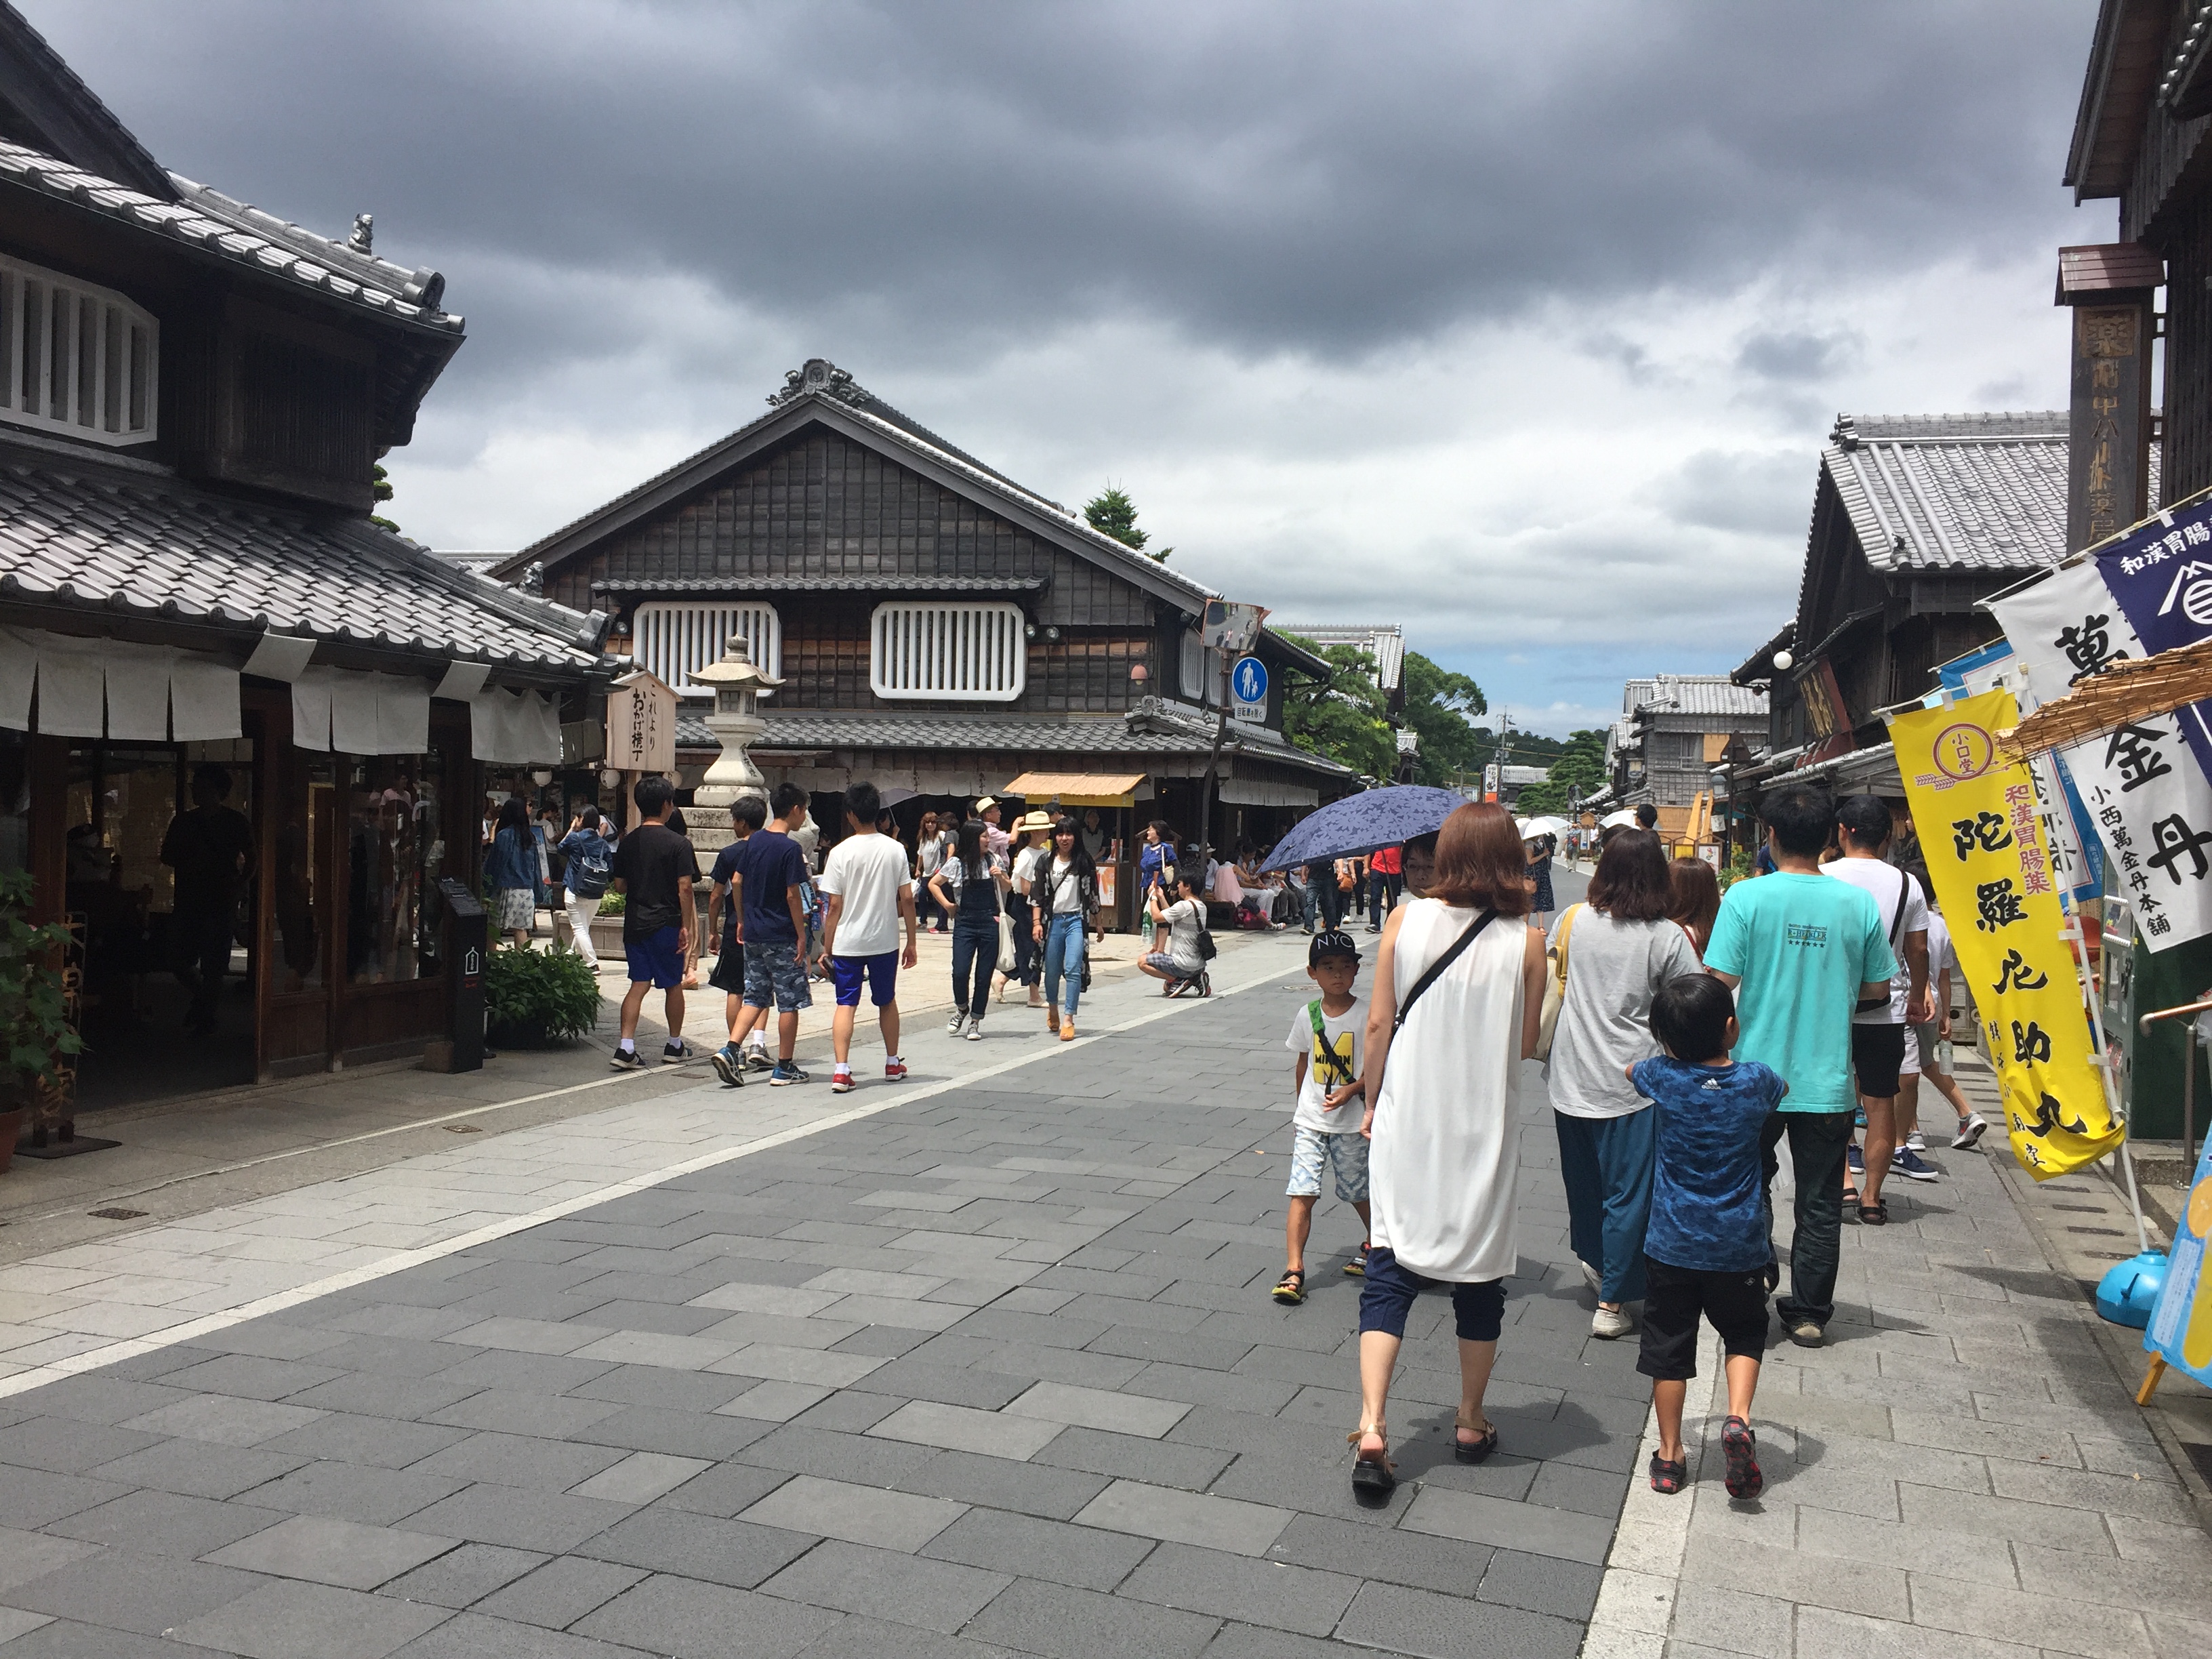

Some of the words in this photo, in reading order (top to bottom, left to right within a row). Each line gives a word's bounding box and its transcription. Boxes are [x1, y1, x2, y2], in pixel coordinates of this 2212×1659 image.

[2120, 514, 2212, 575] 和漢胃腸
[632, 688, 647, 762] おかげ横丁
[649, 684, 657, 751] これより
[2005, 784, 2051, 895] 和漢胃腸薬
[2090, 785, 2171, 937] 小西萬金丹本舗
[1317, 933, 1352, 949] NYC
[1952, 812, 2088, 1138] 陀羅尼助丸
